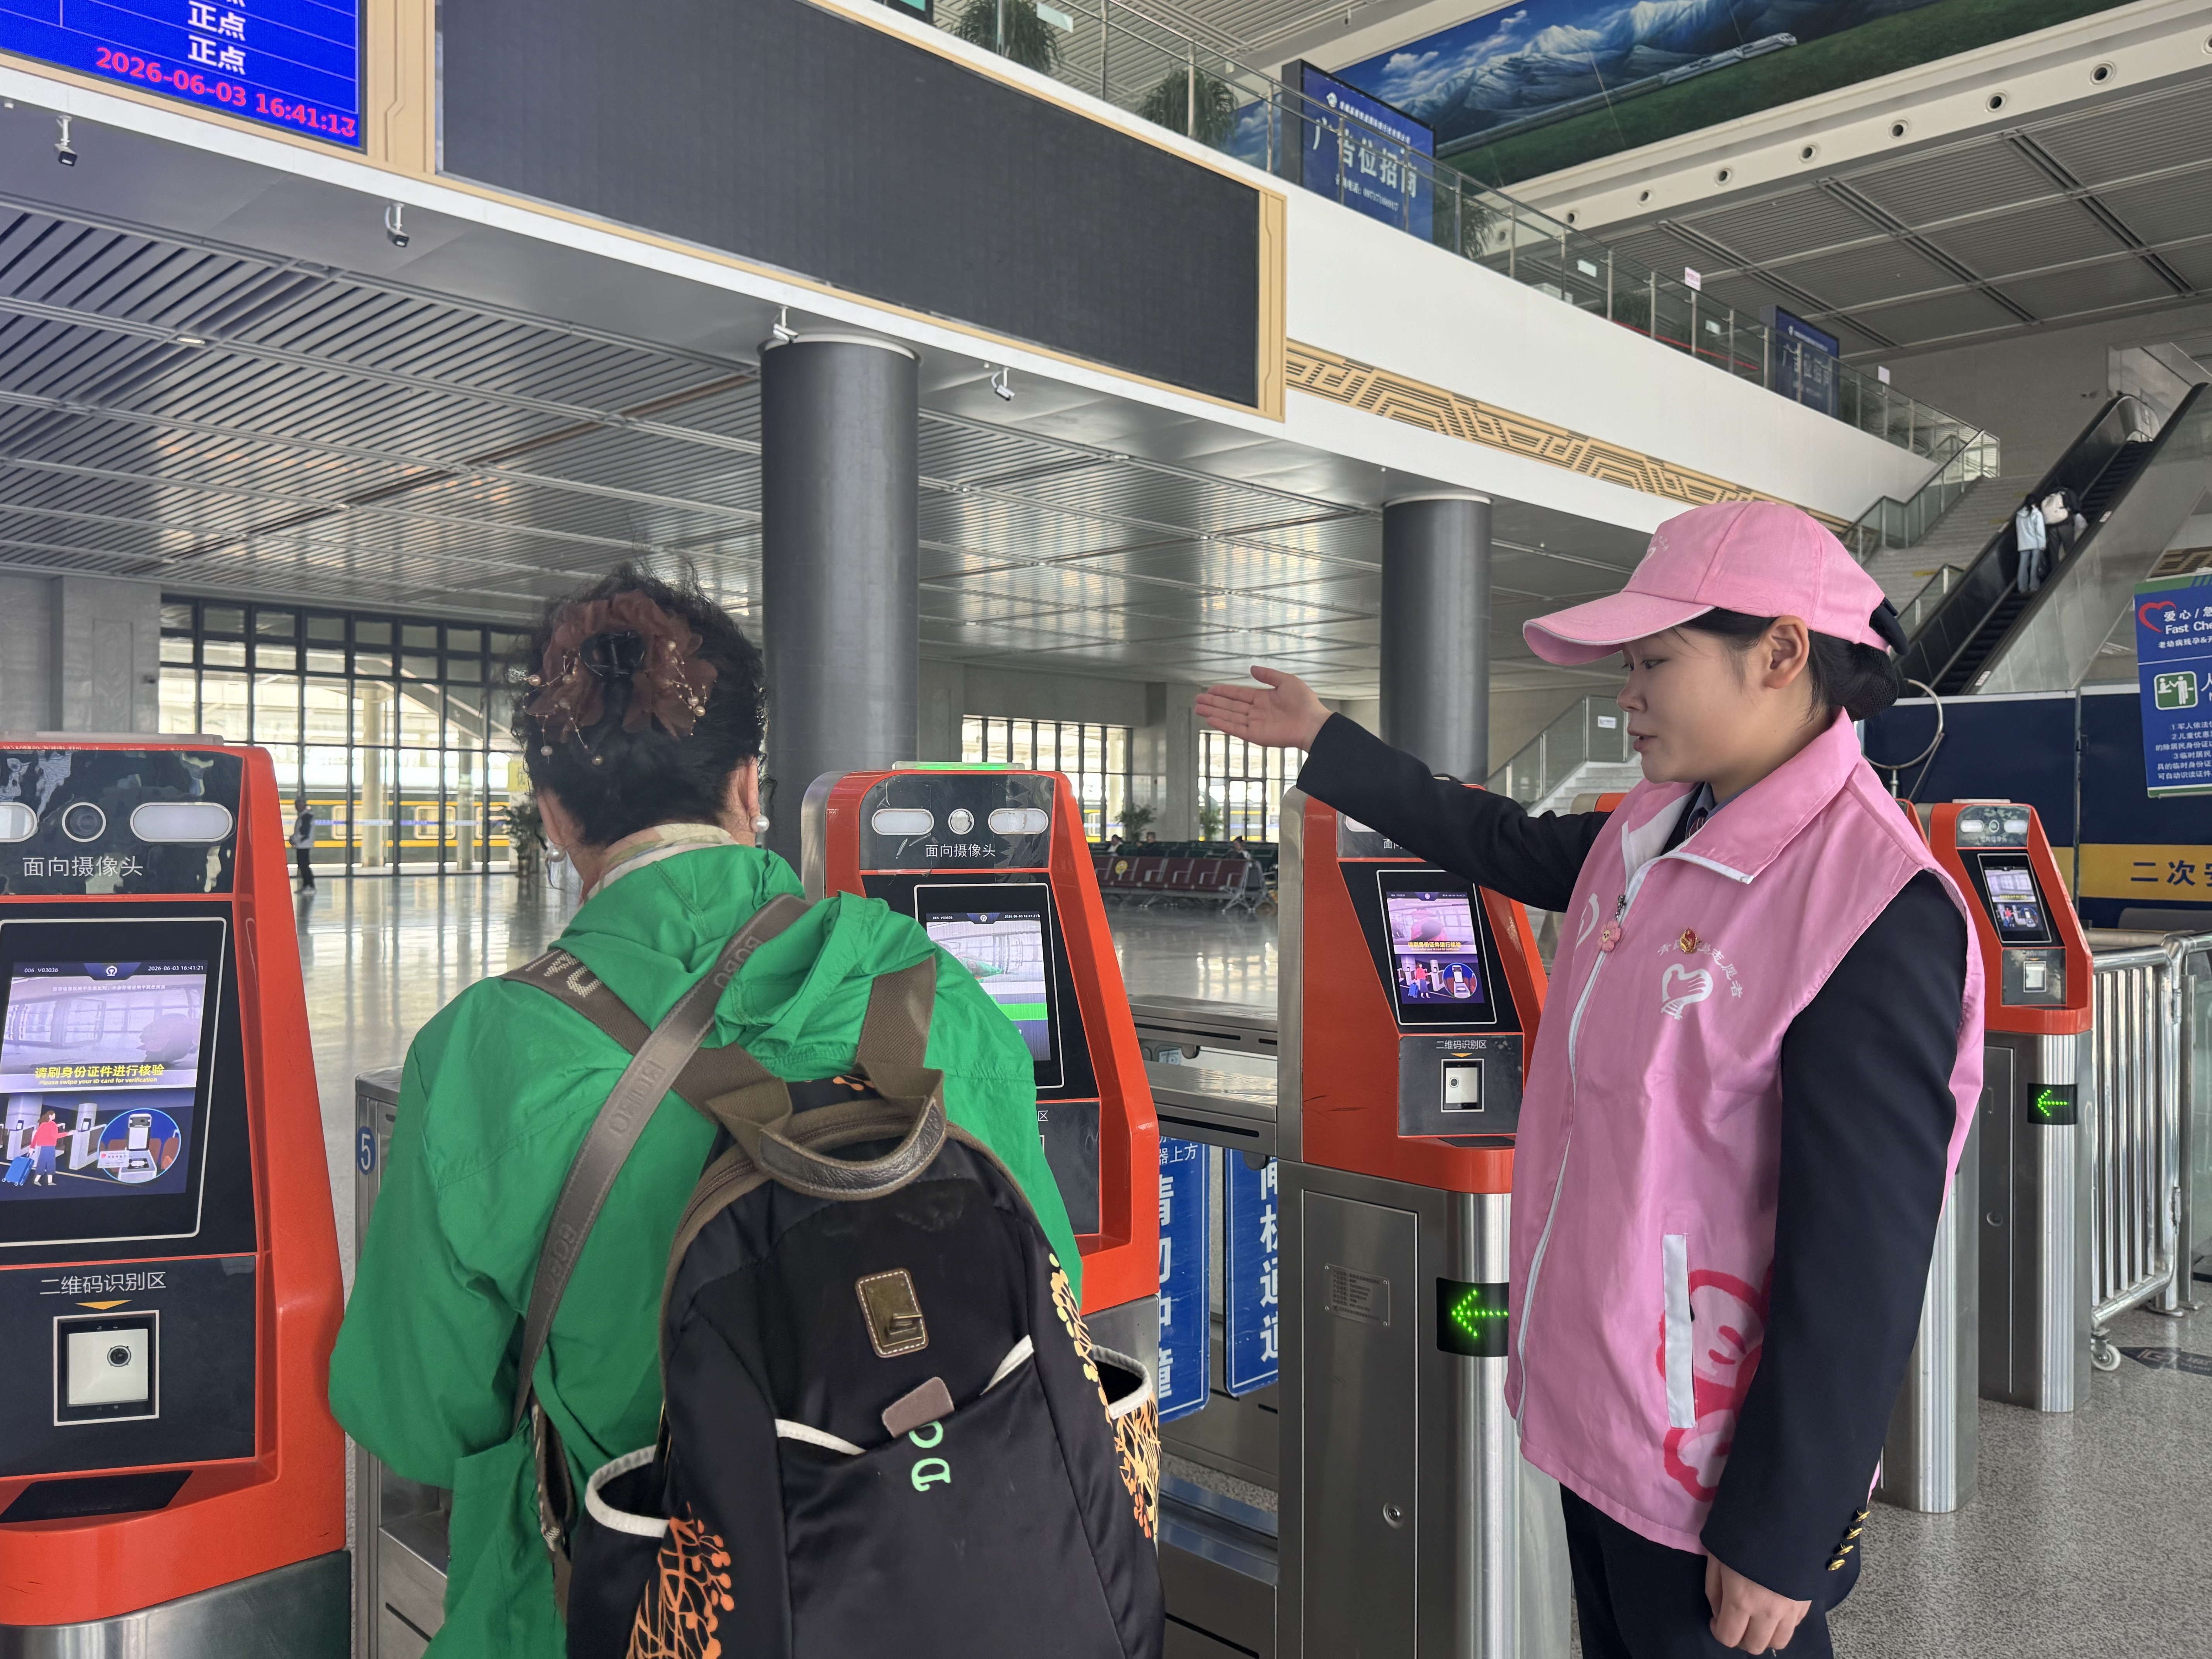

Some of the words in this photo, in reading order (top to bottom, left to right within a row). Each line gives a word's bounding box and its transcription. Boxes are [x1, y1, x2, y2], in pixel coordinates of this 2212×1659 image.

[188, 0, 246, 41] 正点
[188, 34, 246, 75] 正点
[96, 47, 246, 106] 2026-06-03
[2165, 623, 2189, 635] Fast
[925, 844, 996, 858] 面向摄像头
[22, 856, 143, 877] 面向摄像头
[1436, 1040, 1487, 1049] 二维码识别区
[35, 1064, 165, 1079] 请刷身份证件进行核验
[361, 1133, 371, 1170] 5
[40, 1271, 167, 1295] 二维码识别区
